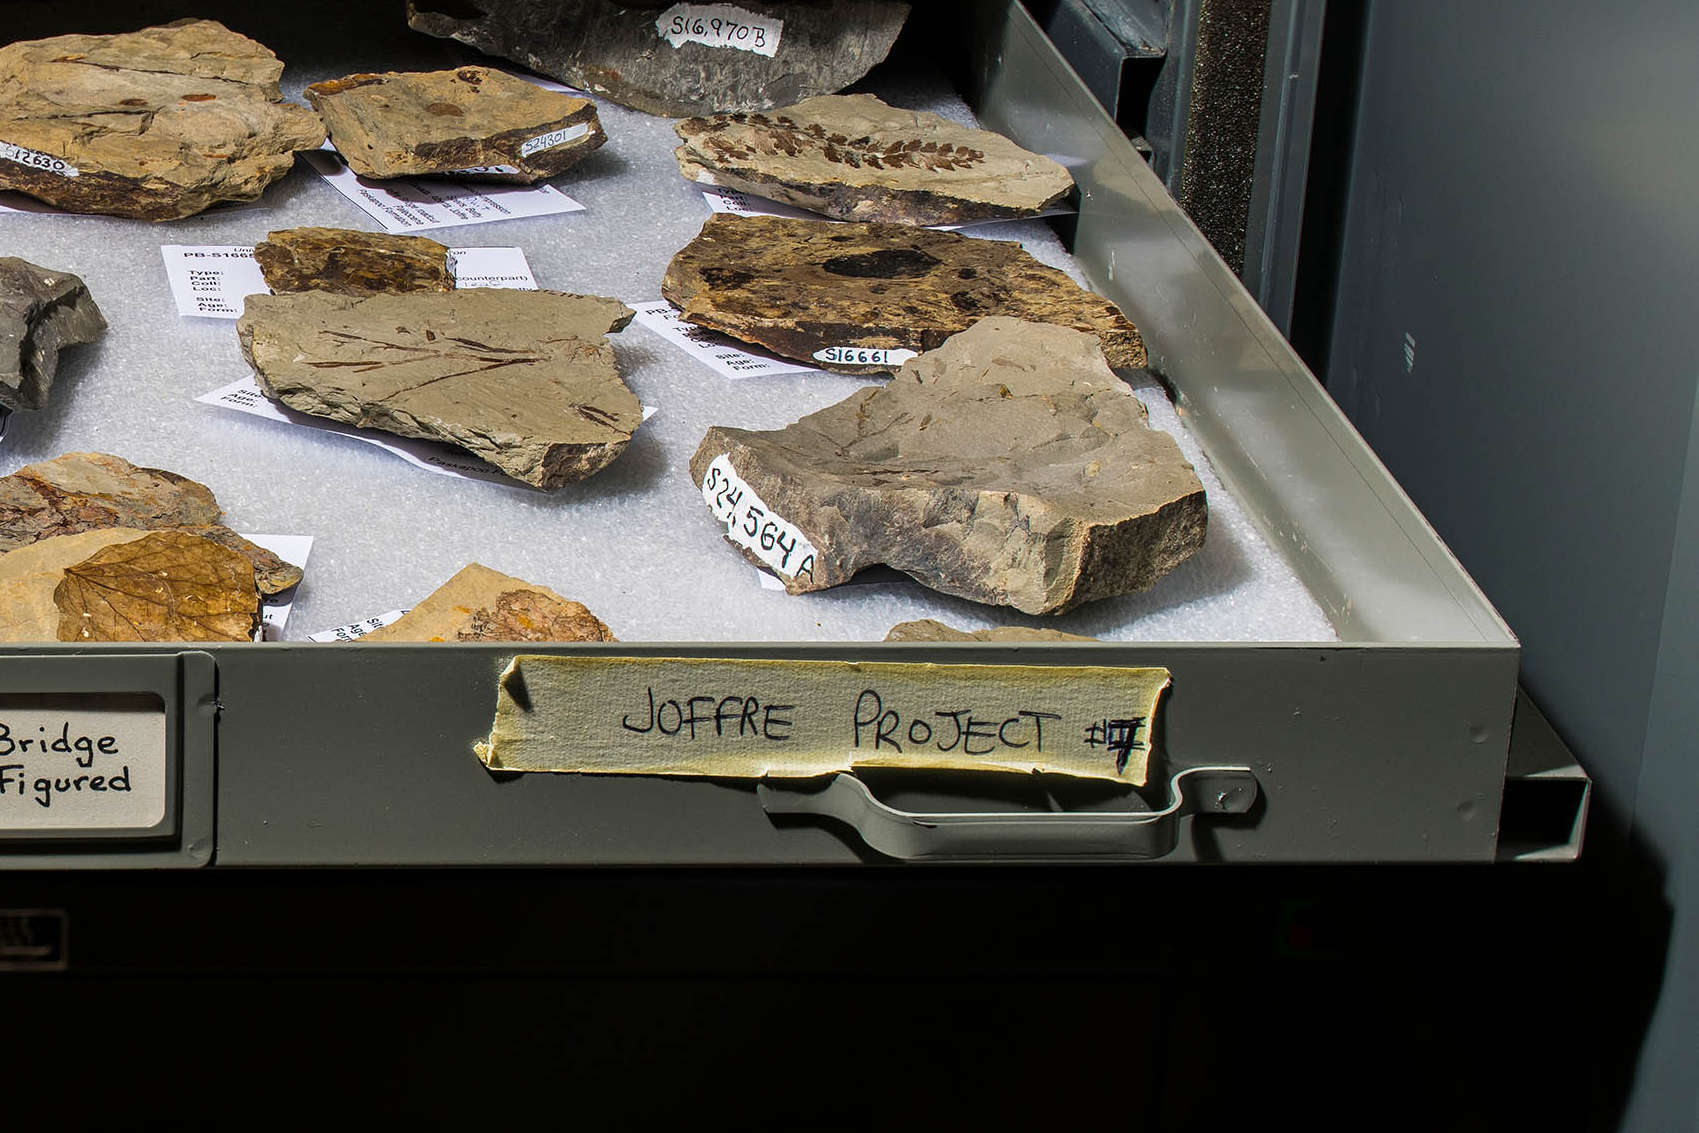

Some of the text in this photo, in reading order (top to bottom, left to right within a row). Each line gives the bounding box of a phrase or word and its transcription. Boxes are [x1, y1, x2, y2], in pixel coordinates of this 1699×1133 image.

[7, 145, 66, 171] S12630
[825, 348, 889, 365] S16661
[622, 684, 796, 742] JOFFRE
